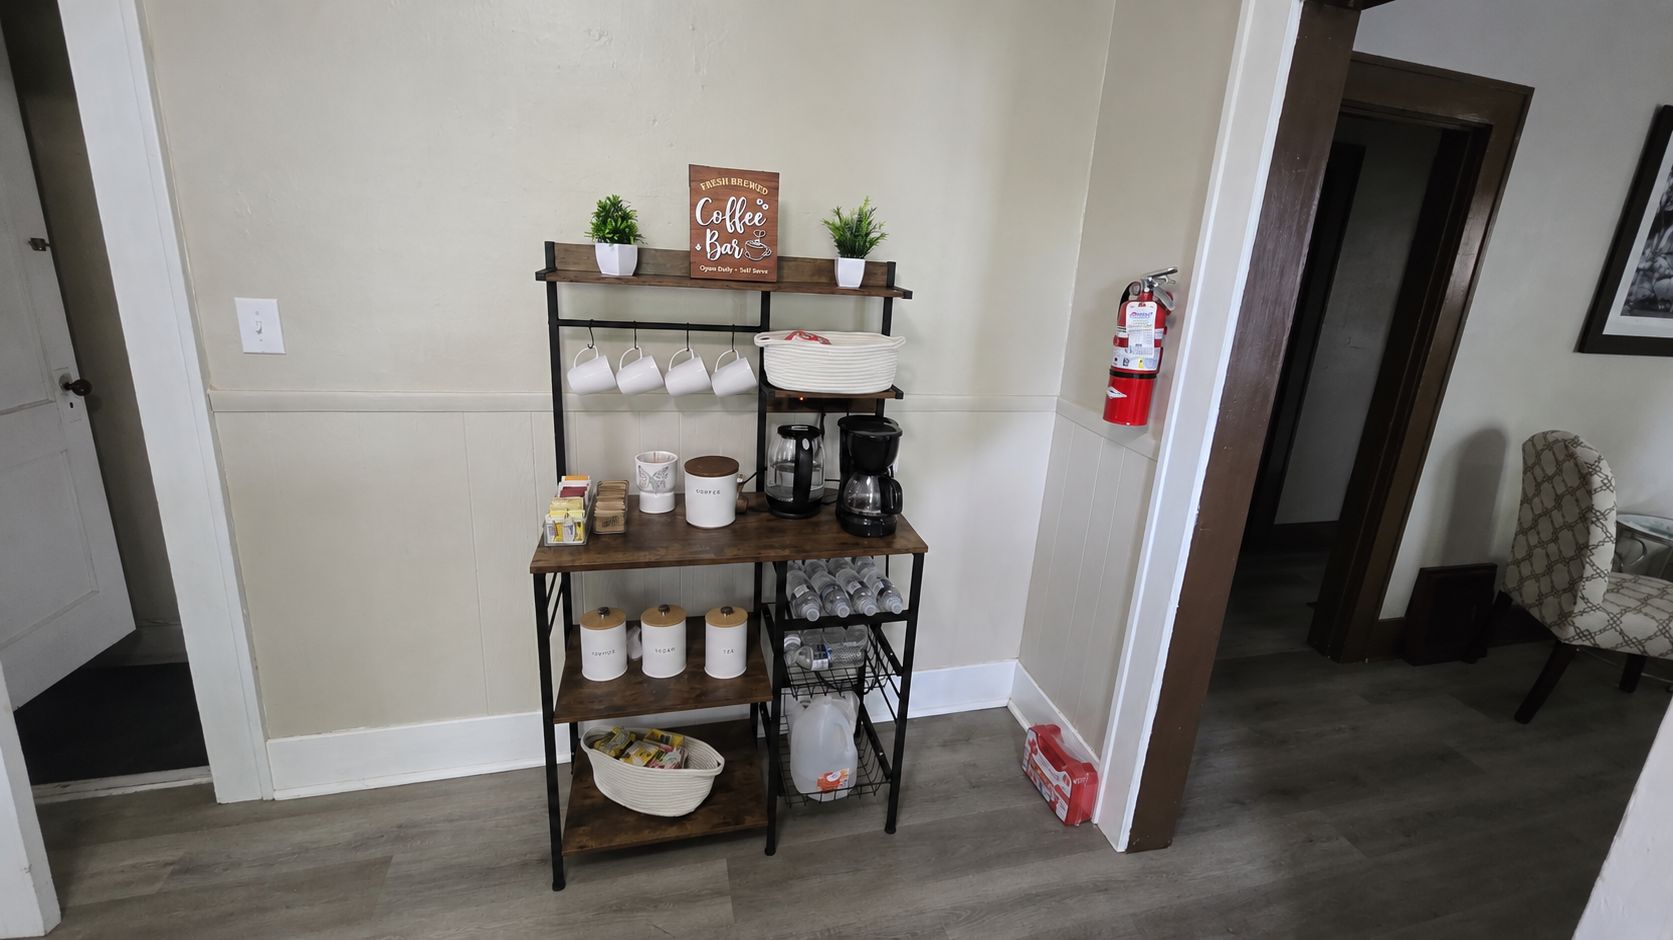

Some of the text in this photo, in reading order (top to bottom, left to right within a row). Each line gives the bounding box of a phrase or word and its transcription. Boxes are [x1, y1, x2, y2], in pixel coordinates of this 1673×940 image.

[700, 177, 769, 195] FRESH BREWED
[695, 196, 767, 233] Coffee
[705, 228, 743, 261] Bar
[699, 264, 717, 273] Open
[717, 265, 734, 274] Daily
